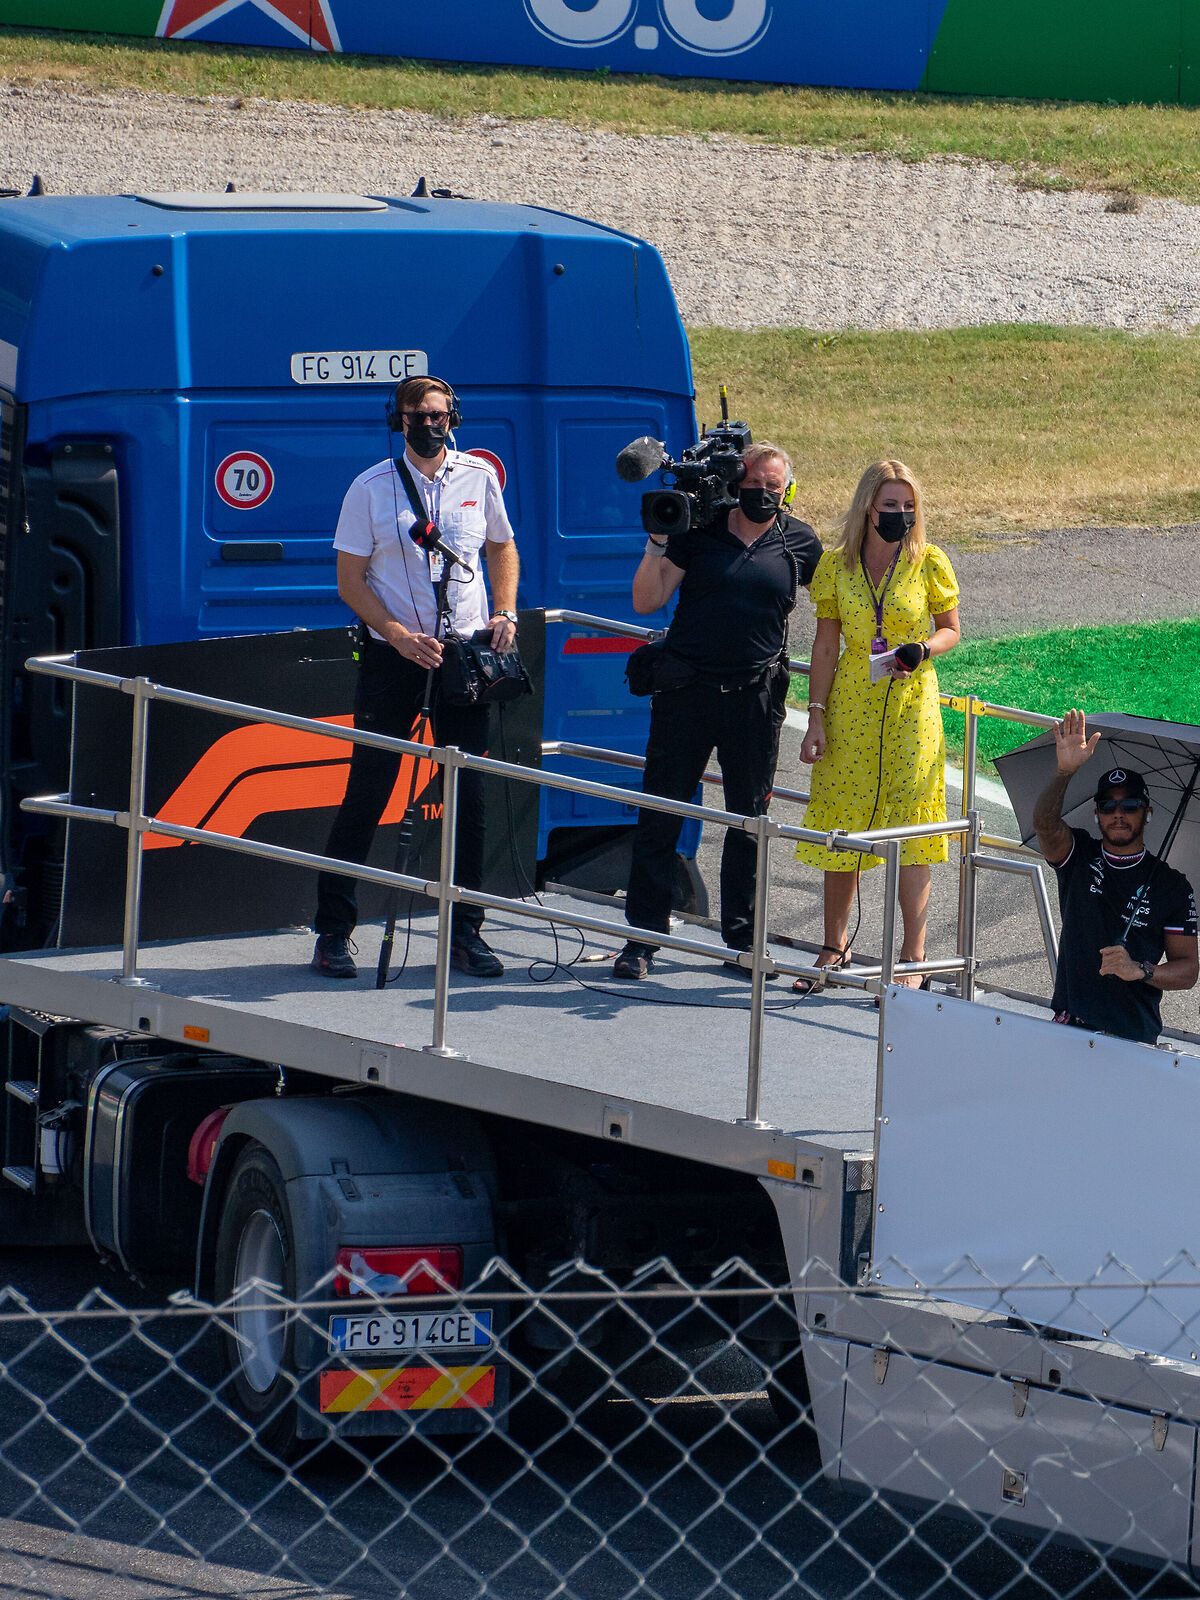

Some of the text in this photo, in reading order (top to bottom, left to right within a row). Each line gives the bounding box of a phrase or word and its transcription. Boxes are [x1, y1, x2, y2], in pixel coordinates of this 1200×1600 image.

[302, 354, 417, 380] FG 914 CE
[233, 468, 260, 491] 70
[350, 1320, 381, 1347] FG
